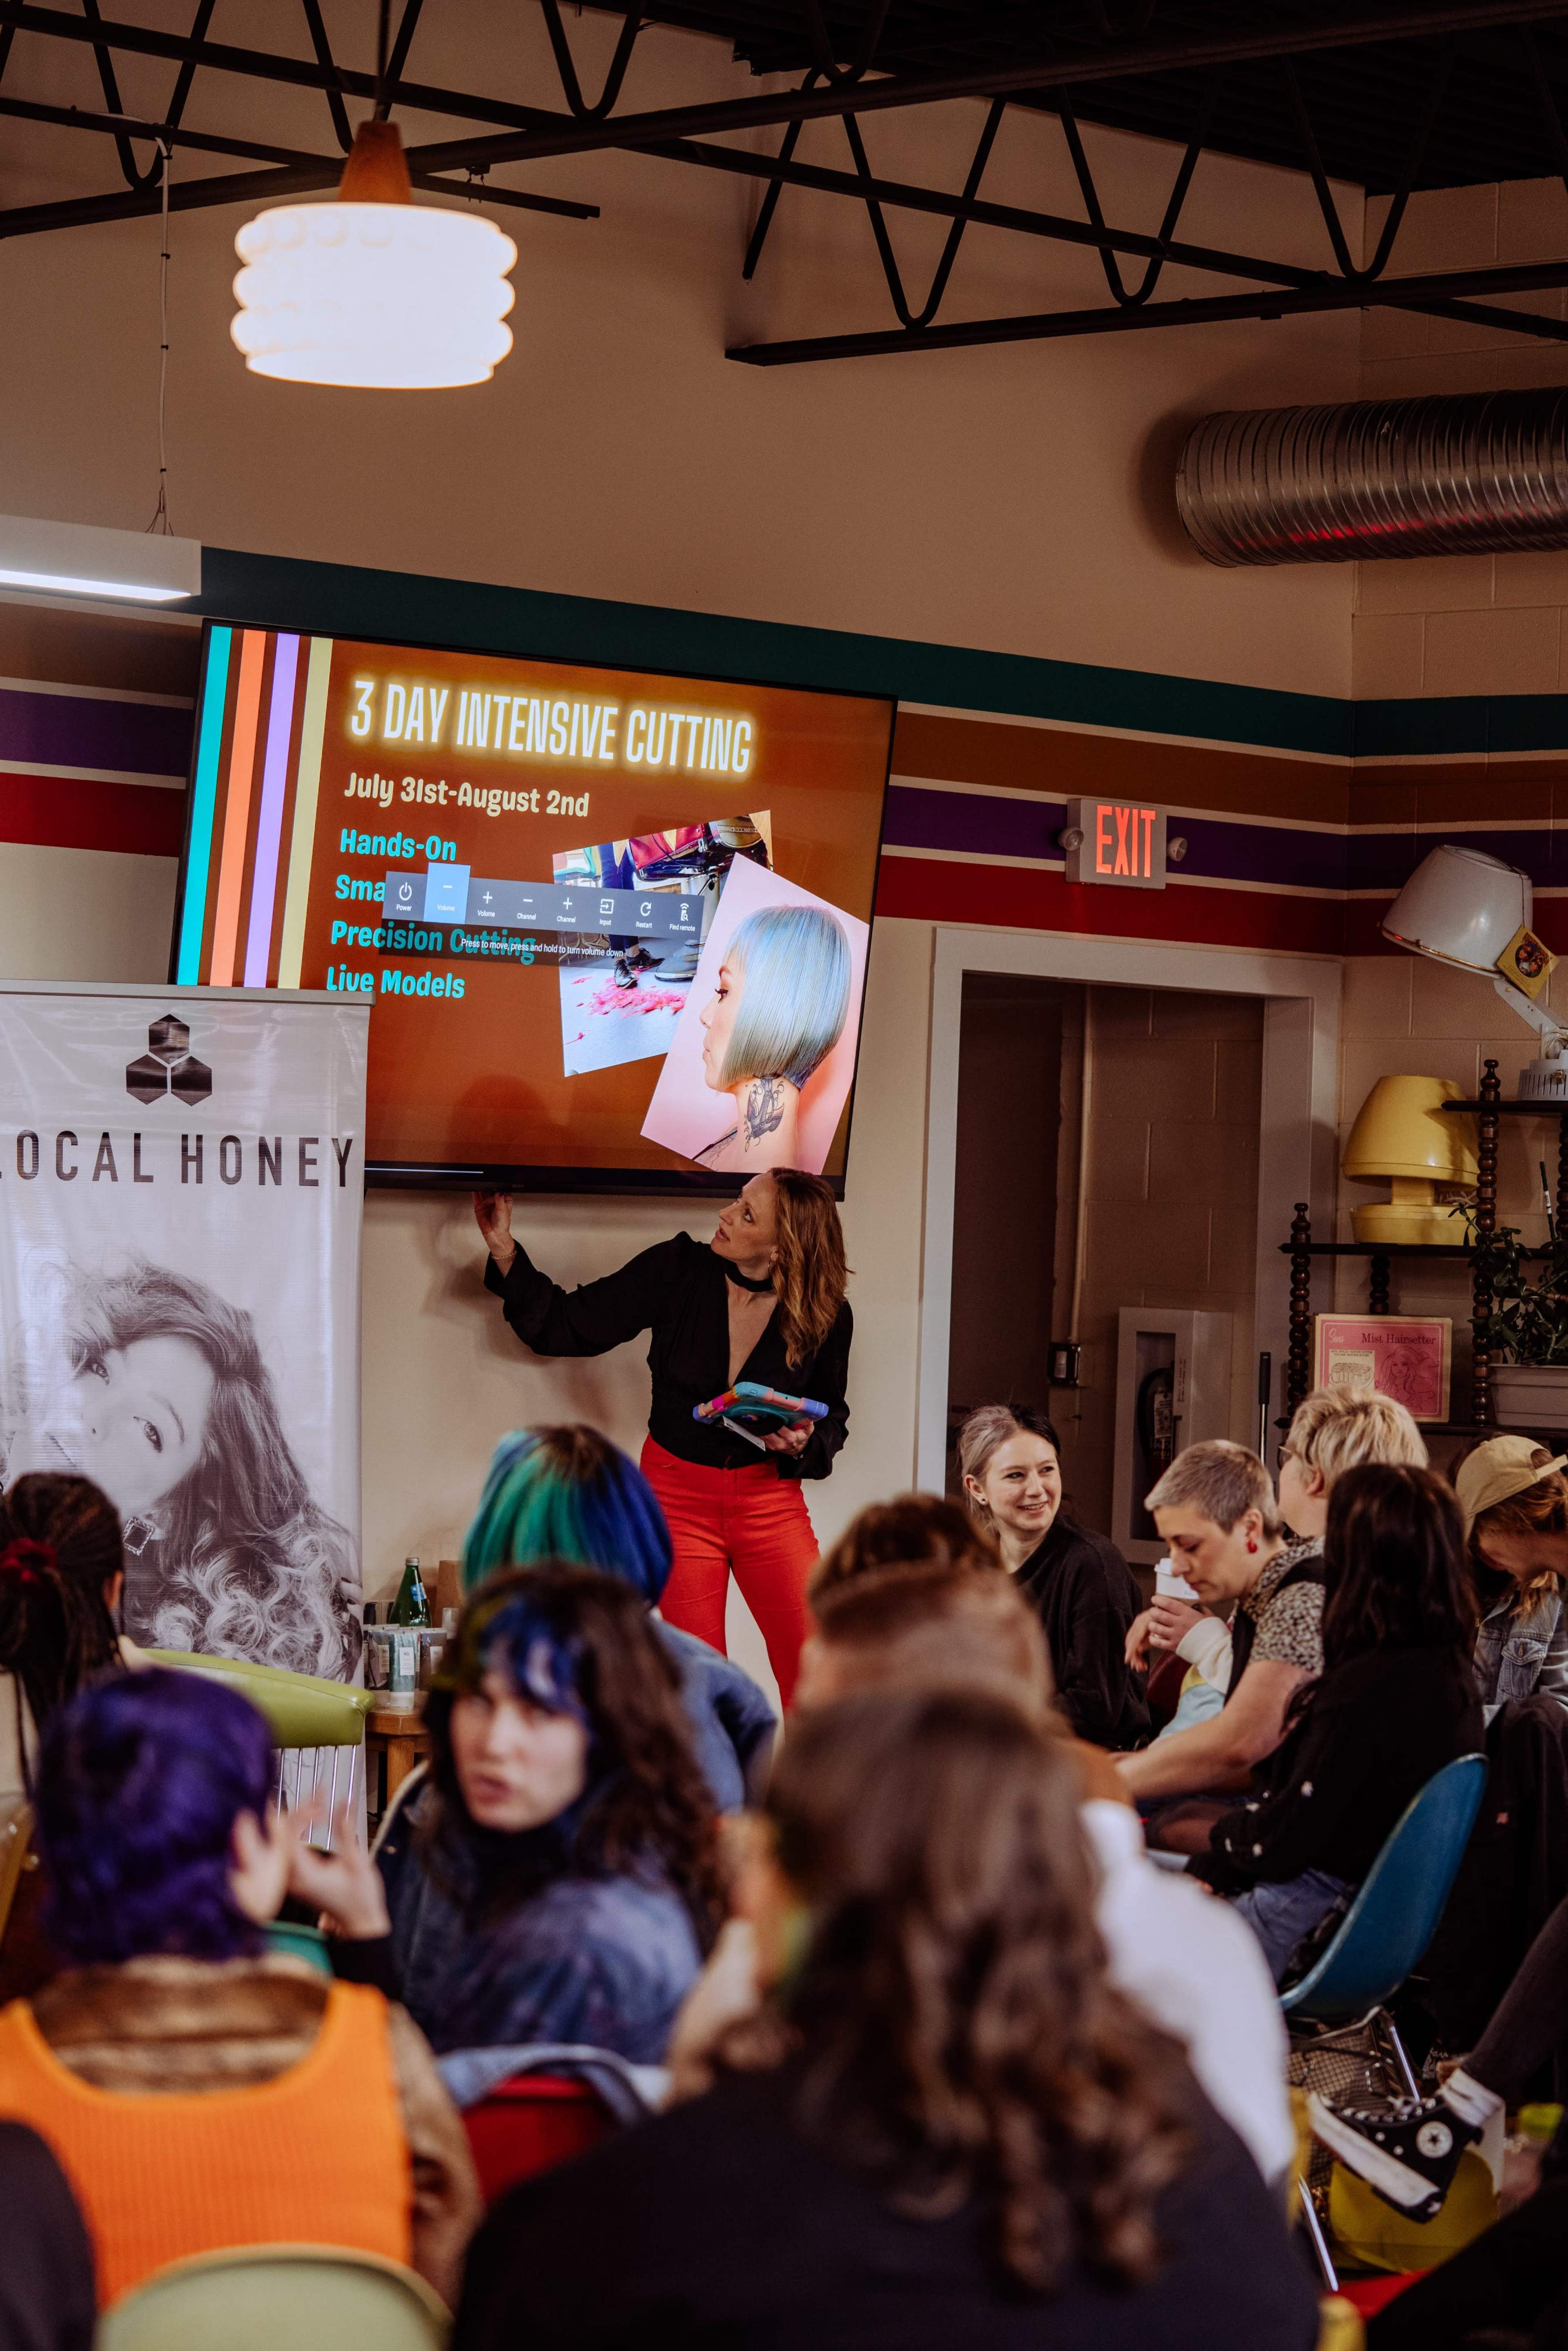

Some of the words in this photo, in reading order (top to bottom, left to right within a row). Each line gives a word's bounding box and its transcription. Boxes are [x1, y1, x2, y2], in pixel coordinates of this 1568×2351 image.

[352, 680, 374, 736] 3
[384, 684, 448, 743] DAY
[457, 691, 618, 760] INTENSIVE
[626, 709, 751, 773] CUTTING
[344, 772, 394, 807] July
[401, 776, 540, 816] 31st-August
[546, 790, 589, 817] 2nd
[340, 828, 457, 861] Hands-On
[1096, 805, 1156, 877] EXIT
[335, 874, 386, 902] Sma
[330, 920, 443, 952] Precision
[451, 928, 536, 965] Cutting
[461, 938, 480, 948] Press
[481, 940, 489, 948] to
[490, 942, 510, 950] move,
[510, 943, 529, 952] press
[530, 943, 543, 952] and
[543, 944, 558, 953] hold
[567, 946, 580, 954] turn
[581, 947, 605, 956] volume
[606, 948, 624, 957] down
[327, 964, 374, 992] Live
[381, 969, 466, 999] Models
[0, 1129, 154, 1182] OCAL
[181, 1134, 353, 1188] HONEY
[1361, 1332, 1383, 1343] Mist
[1386, 1333, 1436, 1345] Hairsetter
